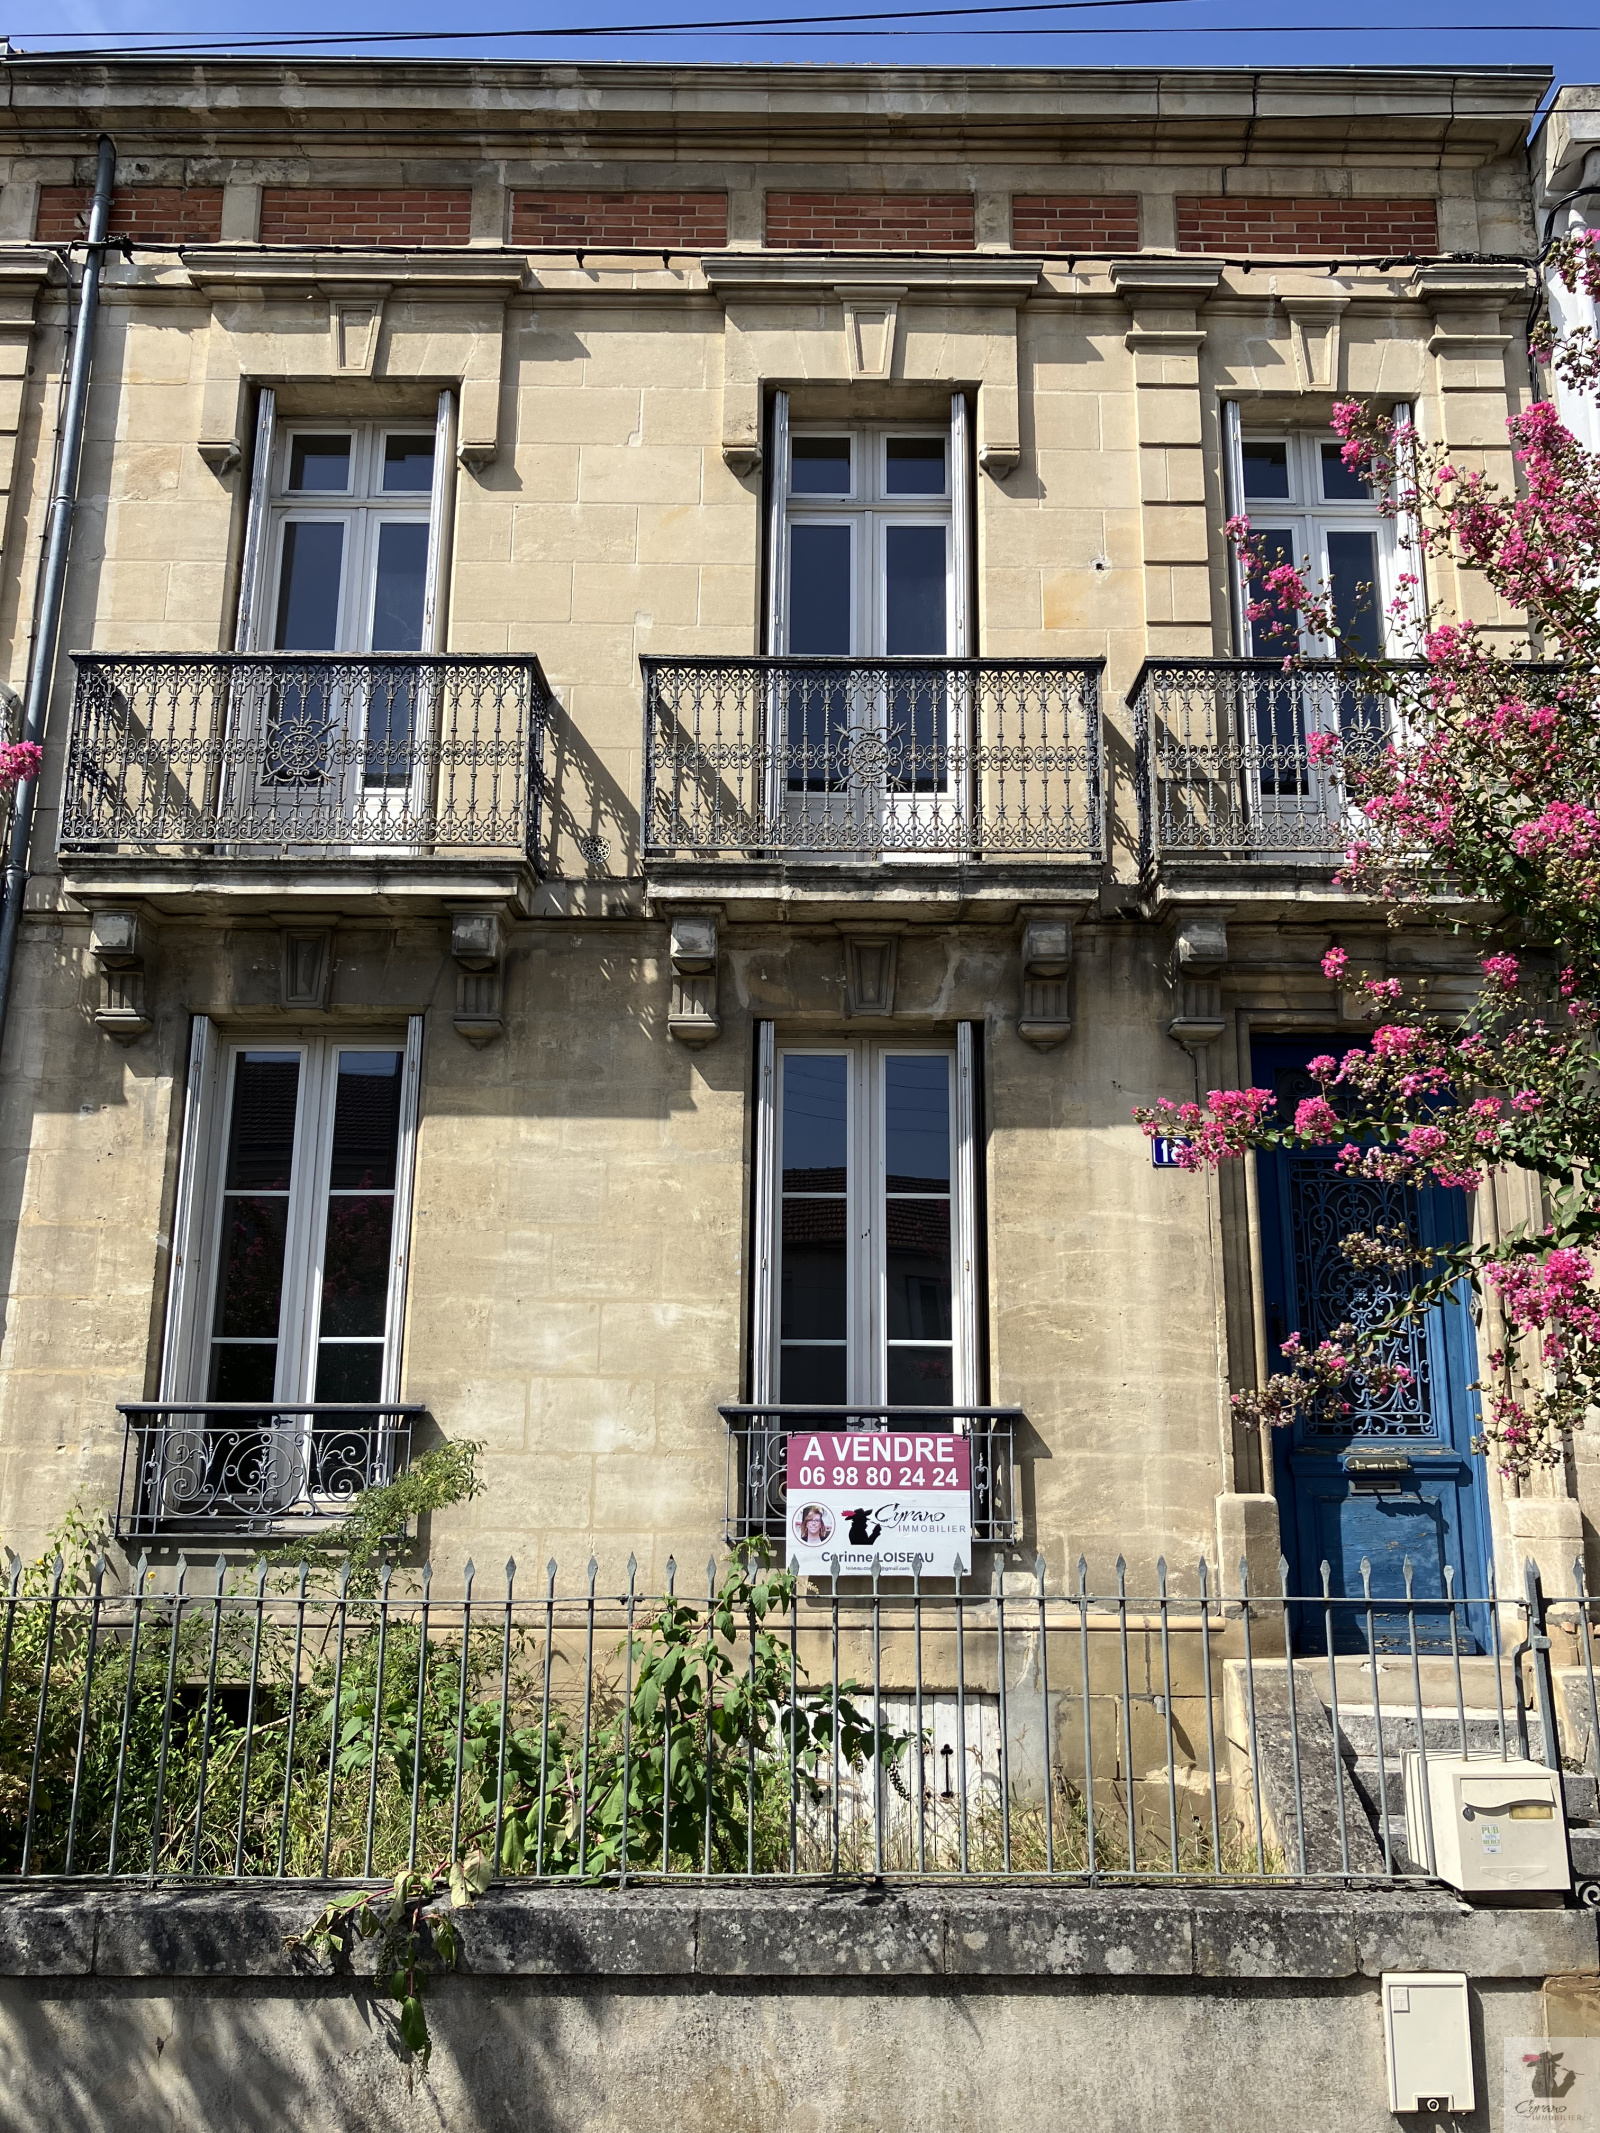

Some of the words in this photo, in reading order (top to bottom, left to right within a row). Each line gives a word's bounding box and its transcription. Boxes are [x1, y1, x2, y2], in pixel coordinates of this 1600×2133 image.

[803, 1436, 825, 1461] A
[832, 1437, 955, 1462] VENDRE
[799, 1466, 826, 1486] 06
[832, 1466, 859, 1486] 98
[866, 1467, 892, 1486] 80
[899, 1467, 926, 1486] 24
[932, 1467, 959, 1487] 24
[874, 1503, 945, 1528] Cyrano
[898, 1524, 966, 1533] IMMOBILIER
[821, 1551, 873, 1563] Corinne
[876, 1551, 934, 1563] LOISEAU
